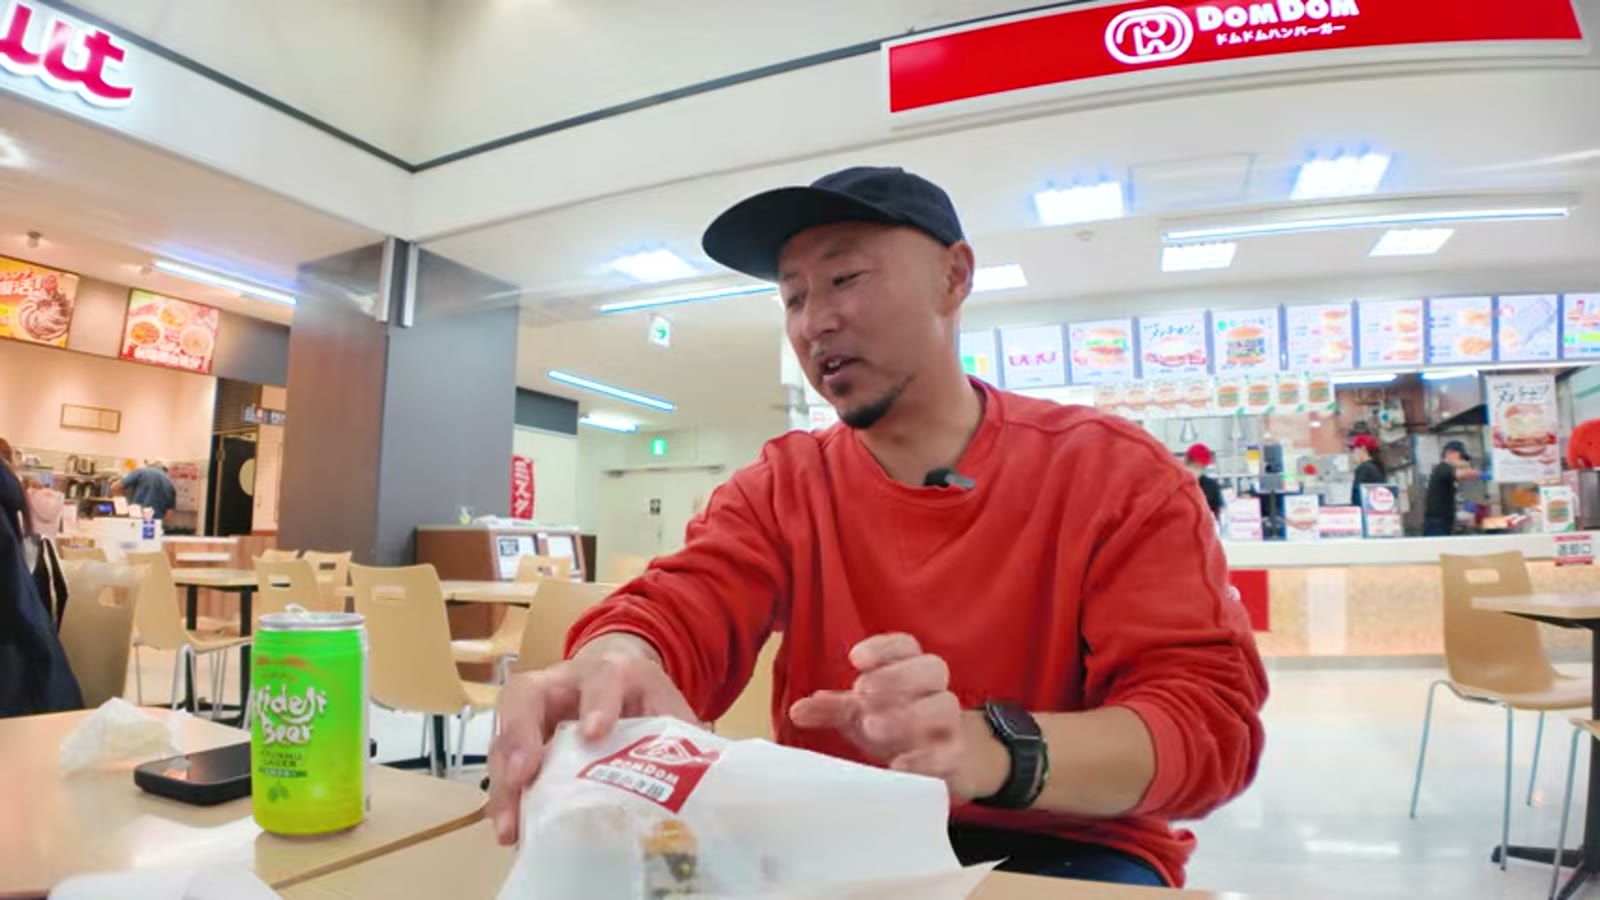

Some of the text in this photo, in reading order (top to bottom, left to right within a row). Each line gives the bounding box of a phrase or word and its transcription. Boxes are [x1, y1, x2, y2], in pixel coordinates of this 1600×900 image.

[0, 3, 133, 99] ut
[1216, 23, 1346, 45] ドムドムハンバーガー
